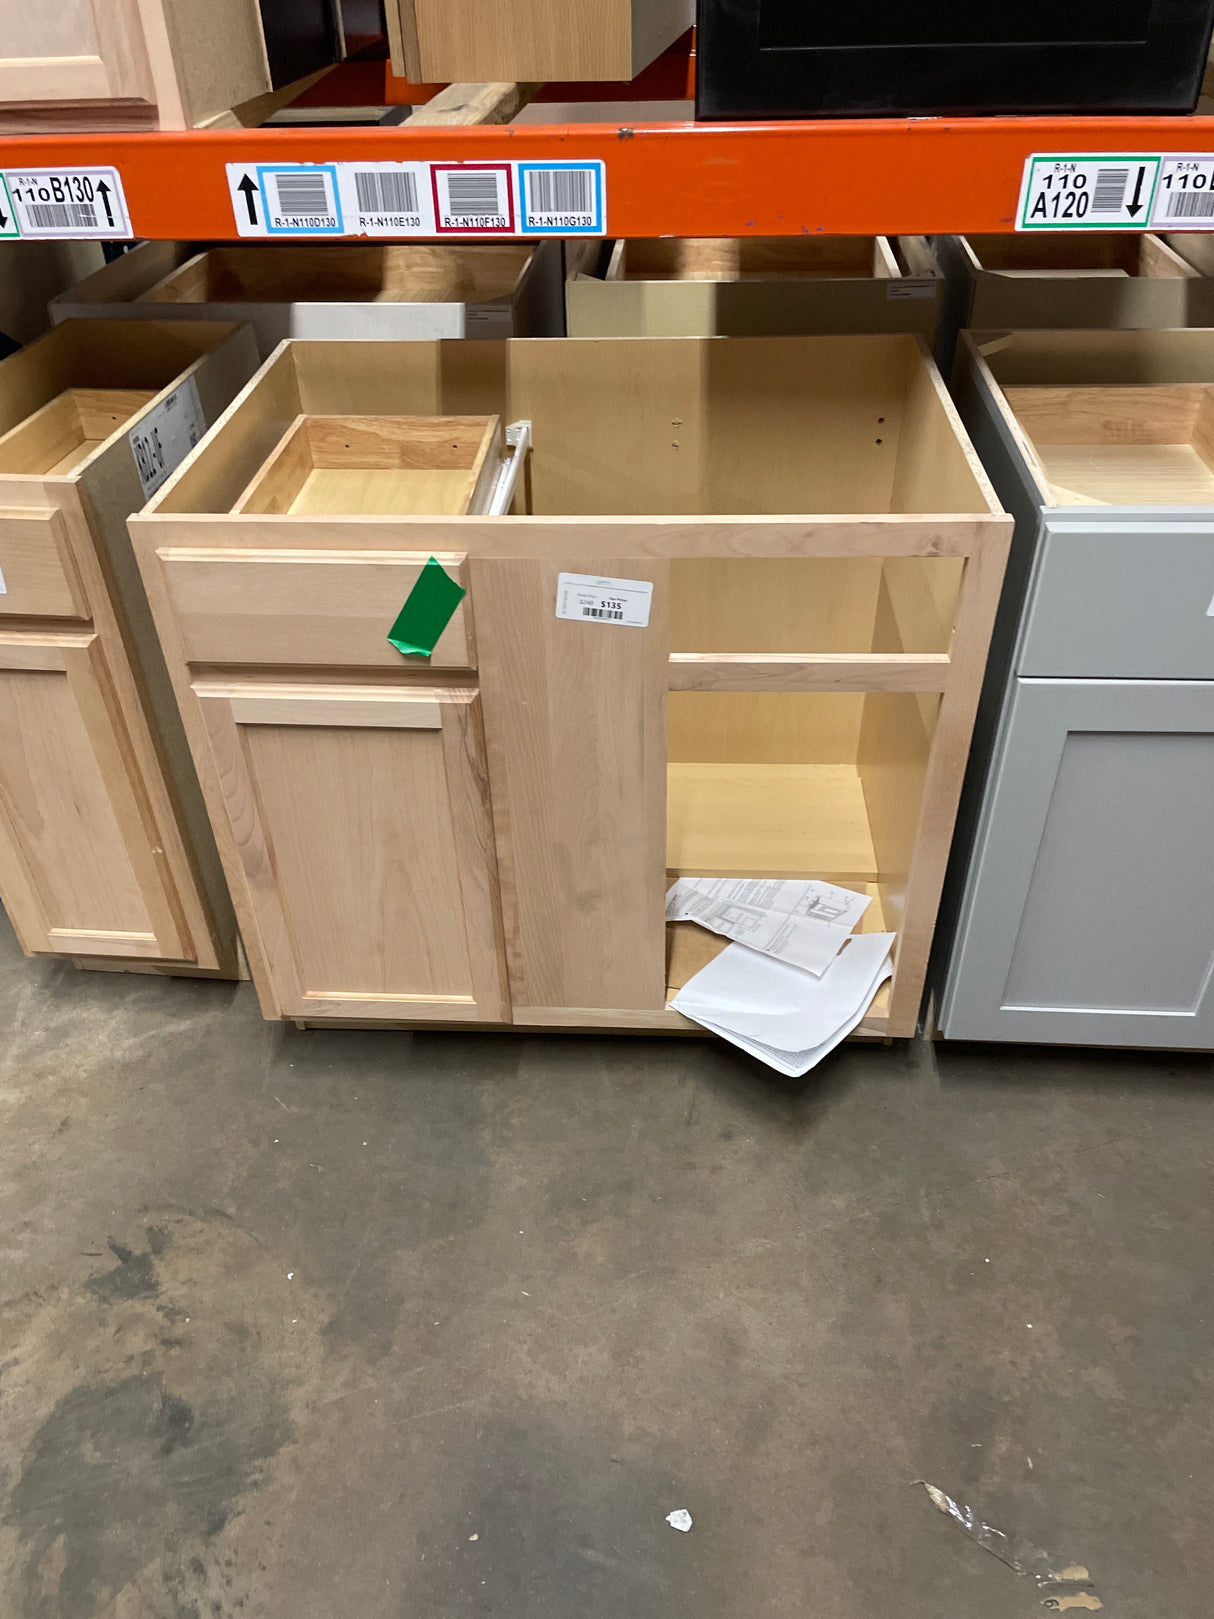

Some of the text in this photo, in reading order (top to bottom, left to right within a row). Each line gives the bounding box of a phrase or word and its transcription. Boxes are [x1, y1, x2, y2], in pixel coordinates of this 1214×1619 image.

[1054, 163, 1077, 173] R-1-N
[1177, 162, 1200, 171] R-1-N
[1043, 174, 1087, 190] 110
[1031, 191, 1089, 218] A120
[275, 217, 336, 228] R-1-N110D130
[359, 217, 420, 227] R-1-N110E130
[444, 217, 506, 227] R-1-N110F130
[528, 216, 592, 226] R-1-N110G130
[601, 600, 622, 610] $135
